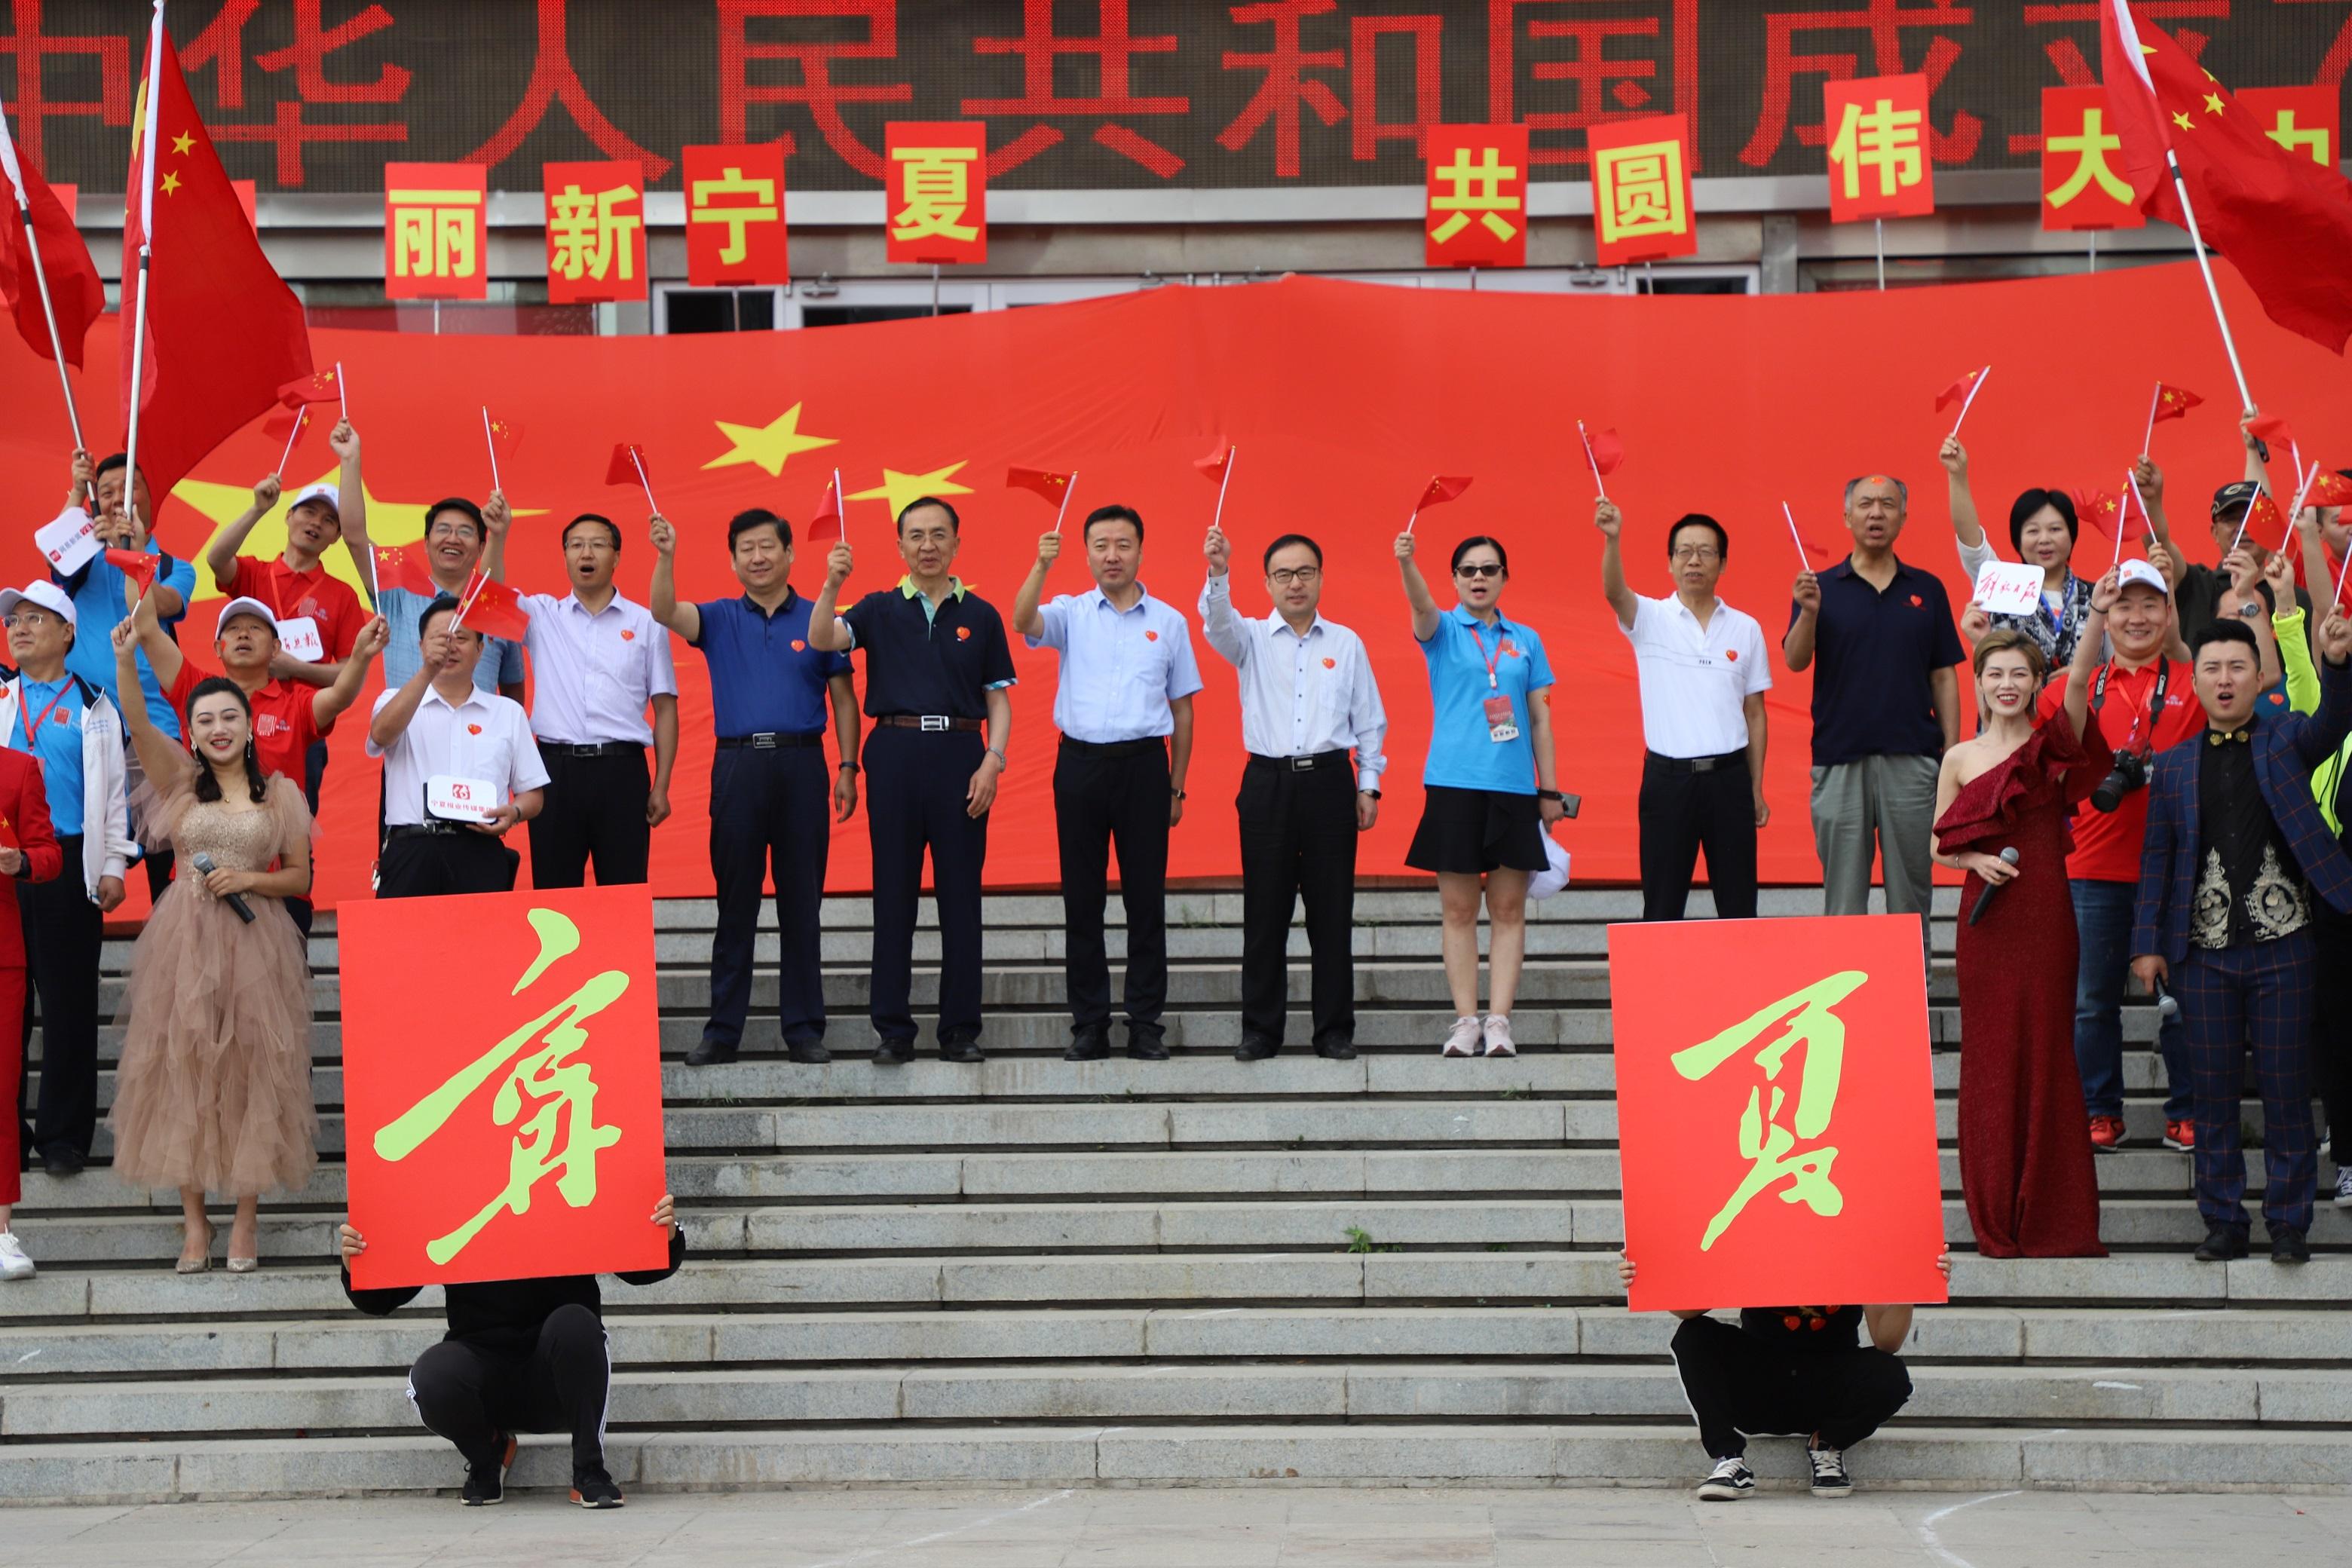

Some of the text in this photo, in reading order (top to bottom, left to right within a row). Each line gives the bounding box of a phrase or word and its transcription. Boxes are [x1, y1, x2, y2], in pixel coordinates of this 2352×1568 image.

[891, 147, 979, 242] 夏
[1429, 148, 1521, 243] 共
[1595, 139, 1687, 244] 圆
[1829, 99, 1923, 199] 伟
[2045, 108, 2136, 209] 大
[388, 189, 482, 278] 丽
[549, 184, 641, 281] 新
[691, 167, 778, 265] 宁
[1671, 970, 1868, 1251] 夏
